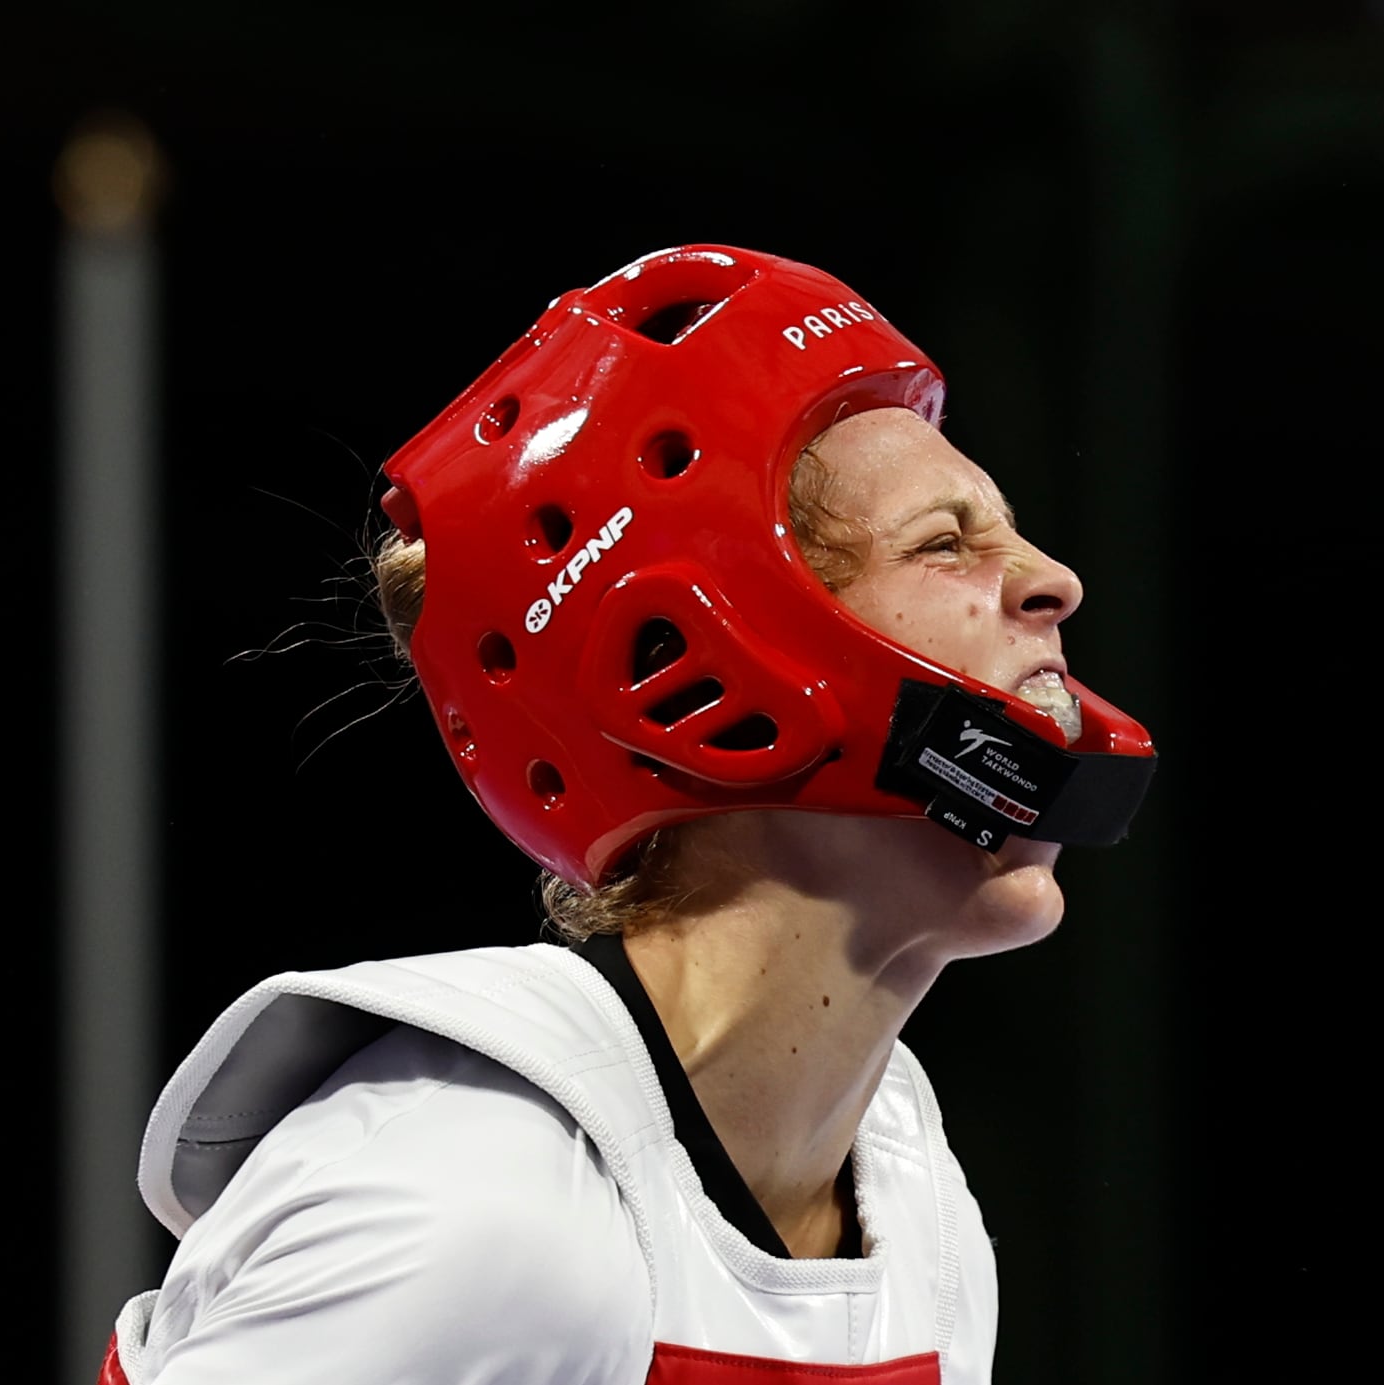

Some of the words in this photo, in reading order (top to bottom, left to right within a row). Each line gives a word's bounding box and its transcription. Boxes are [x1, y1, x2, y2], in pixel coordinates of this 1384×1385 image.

[547, 506, 633, 606] KPNP
[981, 755, 1038, 792] TAEKWONDO
[985, 747, 1020, 772] WORLD
[943, 811, 967, 830] KPNP
